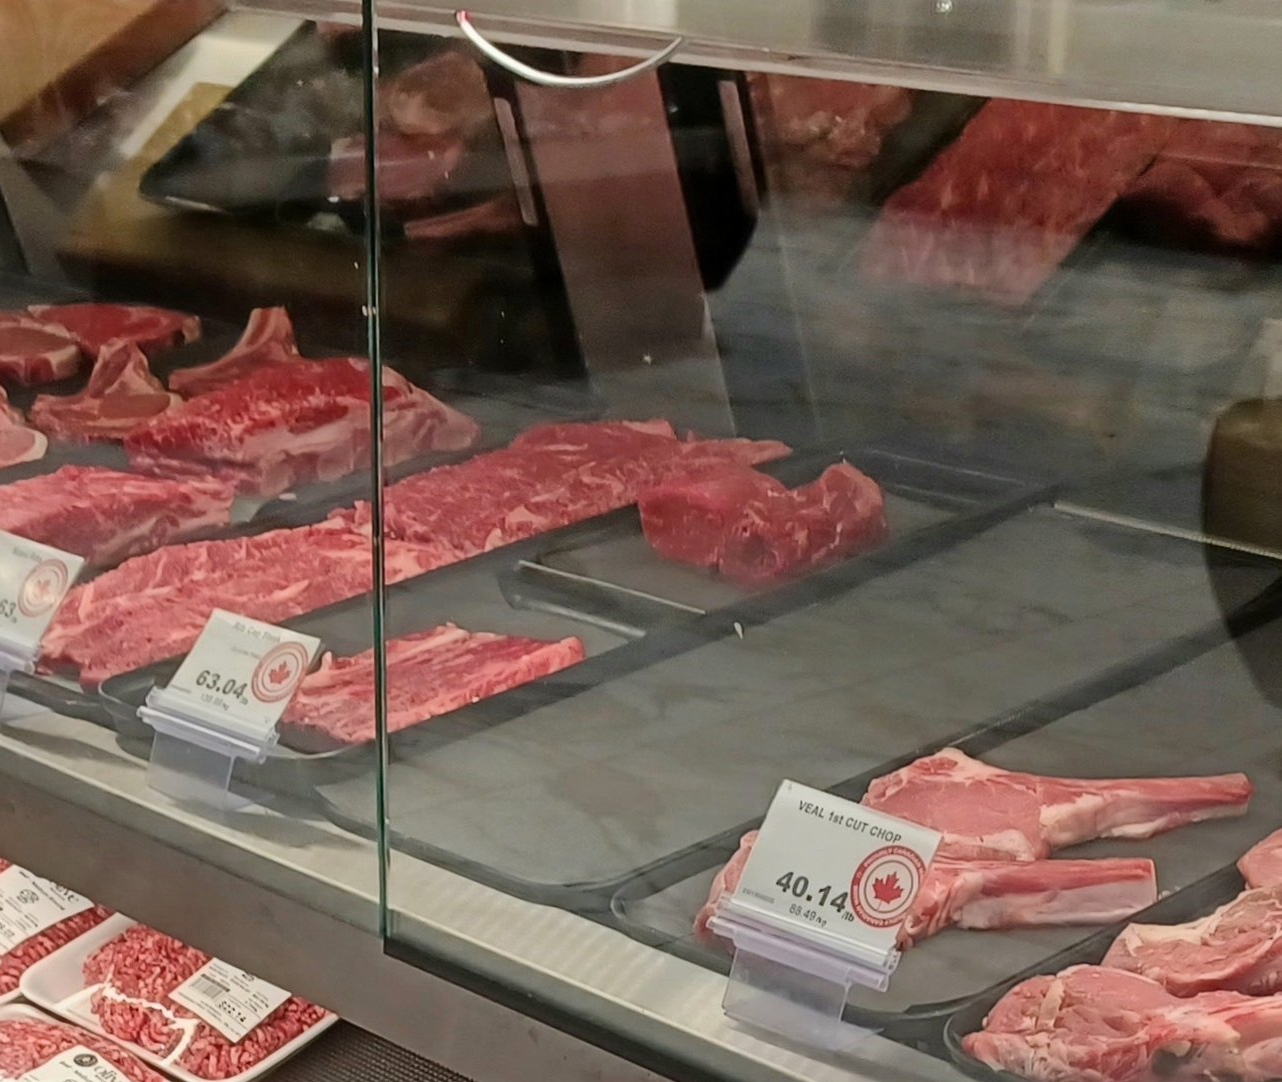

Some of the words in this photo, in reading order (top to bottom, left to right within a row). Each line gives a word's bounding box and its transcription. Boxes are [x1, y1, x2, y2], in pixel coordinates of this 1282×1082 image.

[196, 669, 248, 699] 63.04
[798, 800, 825, 819] VEAL
[828, 811, 844, 825] 1st
[845, 818, 869, 833] CUT
[869, 825, 902, 844] CHOP
[775, 871, 849, 913] 40.14
[842, 910, 855, 923] /lb
